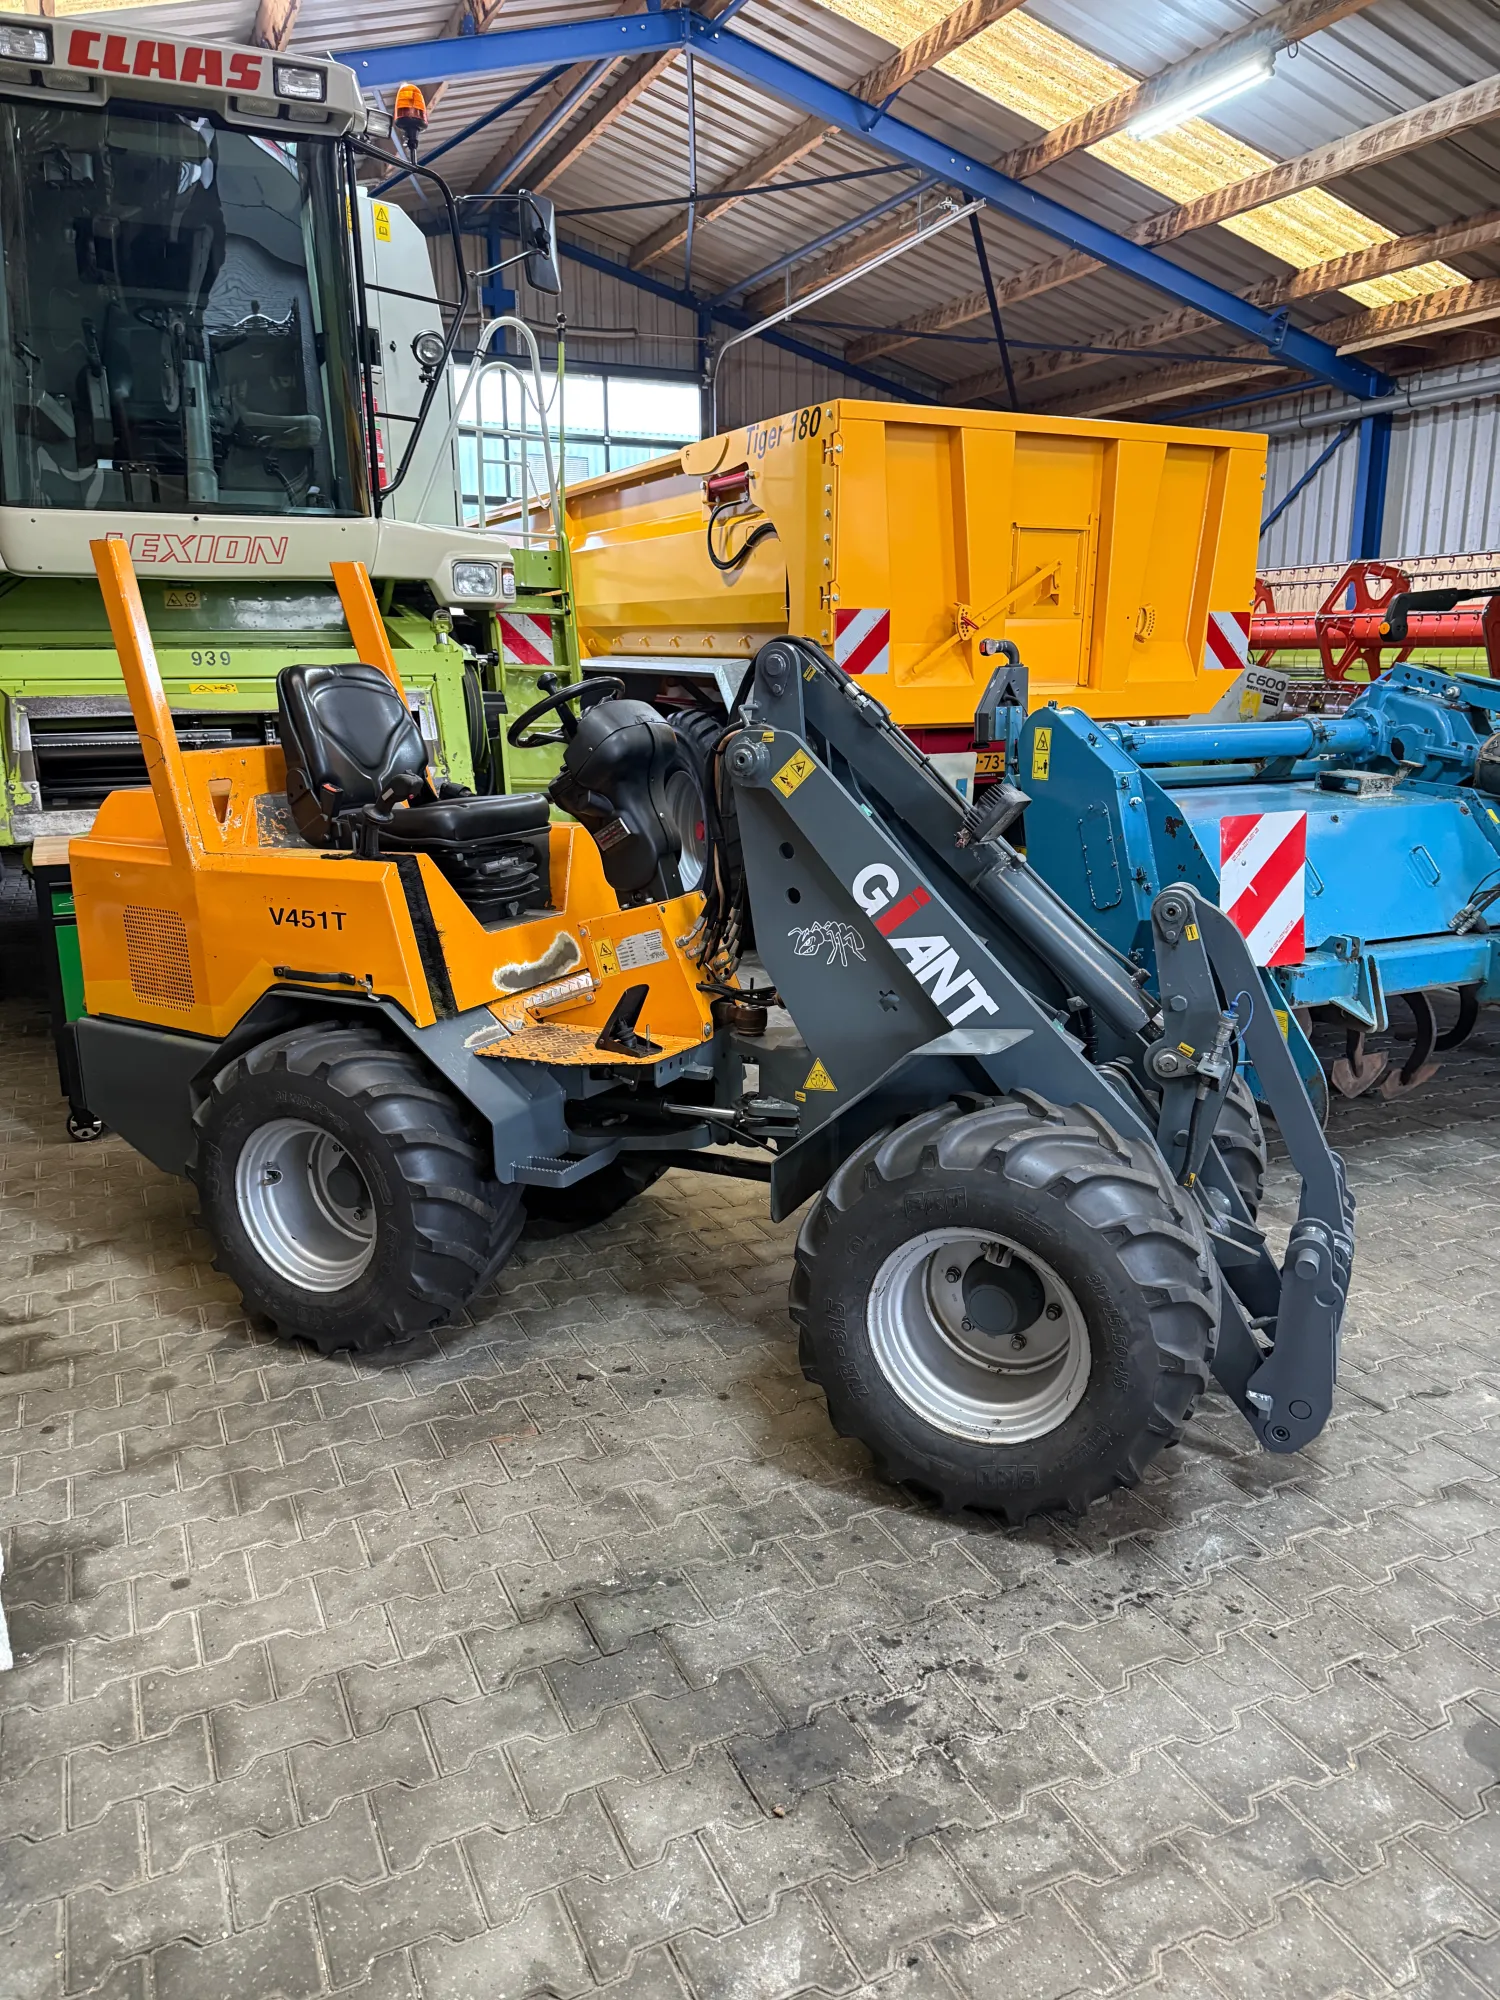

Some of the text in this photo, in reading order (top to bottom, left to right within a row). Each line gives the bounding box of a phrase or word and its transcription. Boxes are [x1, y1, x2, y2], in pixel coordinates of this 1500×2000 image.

[67, 29, 263, 91] CLAAS
[746, 406, 822, 460] Tiger 180
[106, 532, 289, 565] EXION
[191, 650, 232, 667] 939
[1246, 672, 1287, 692] C600
[268, 906, 347, 931] V451T
